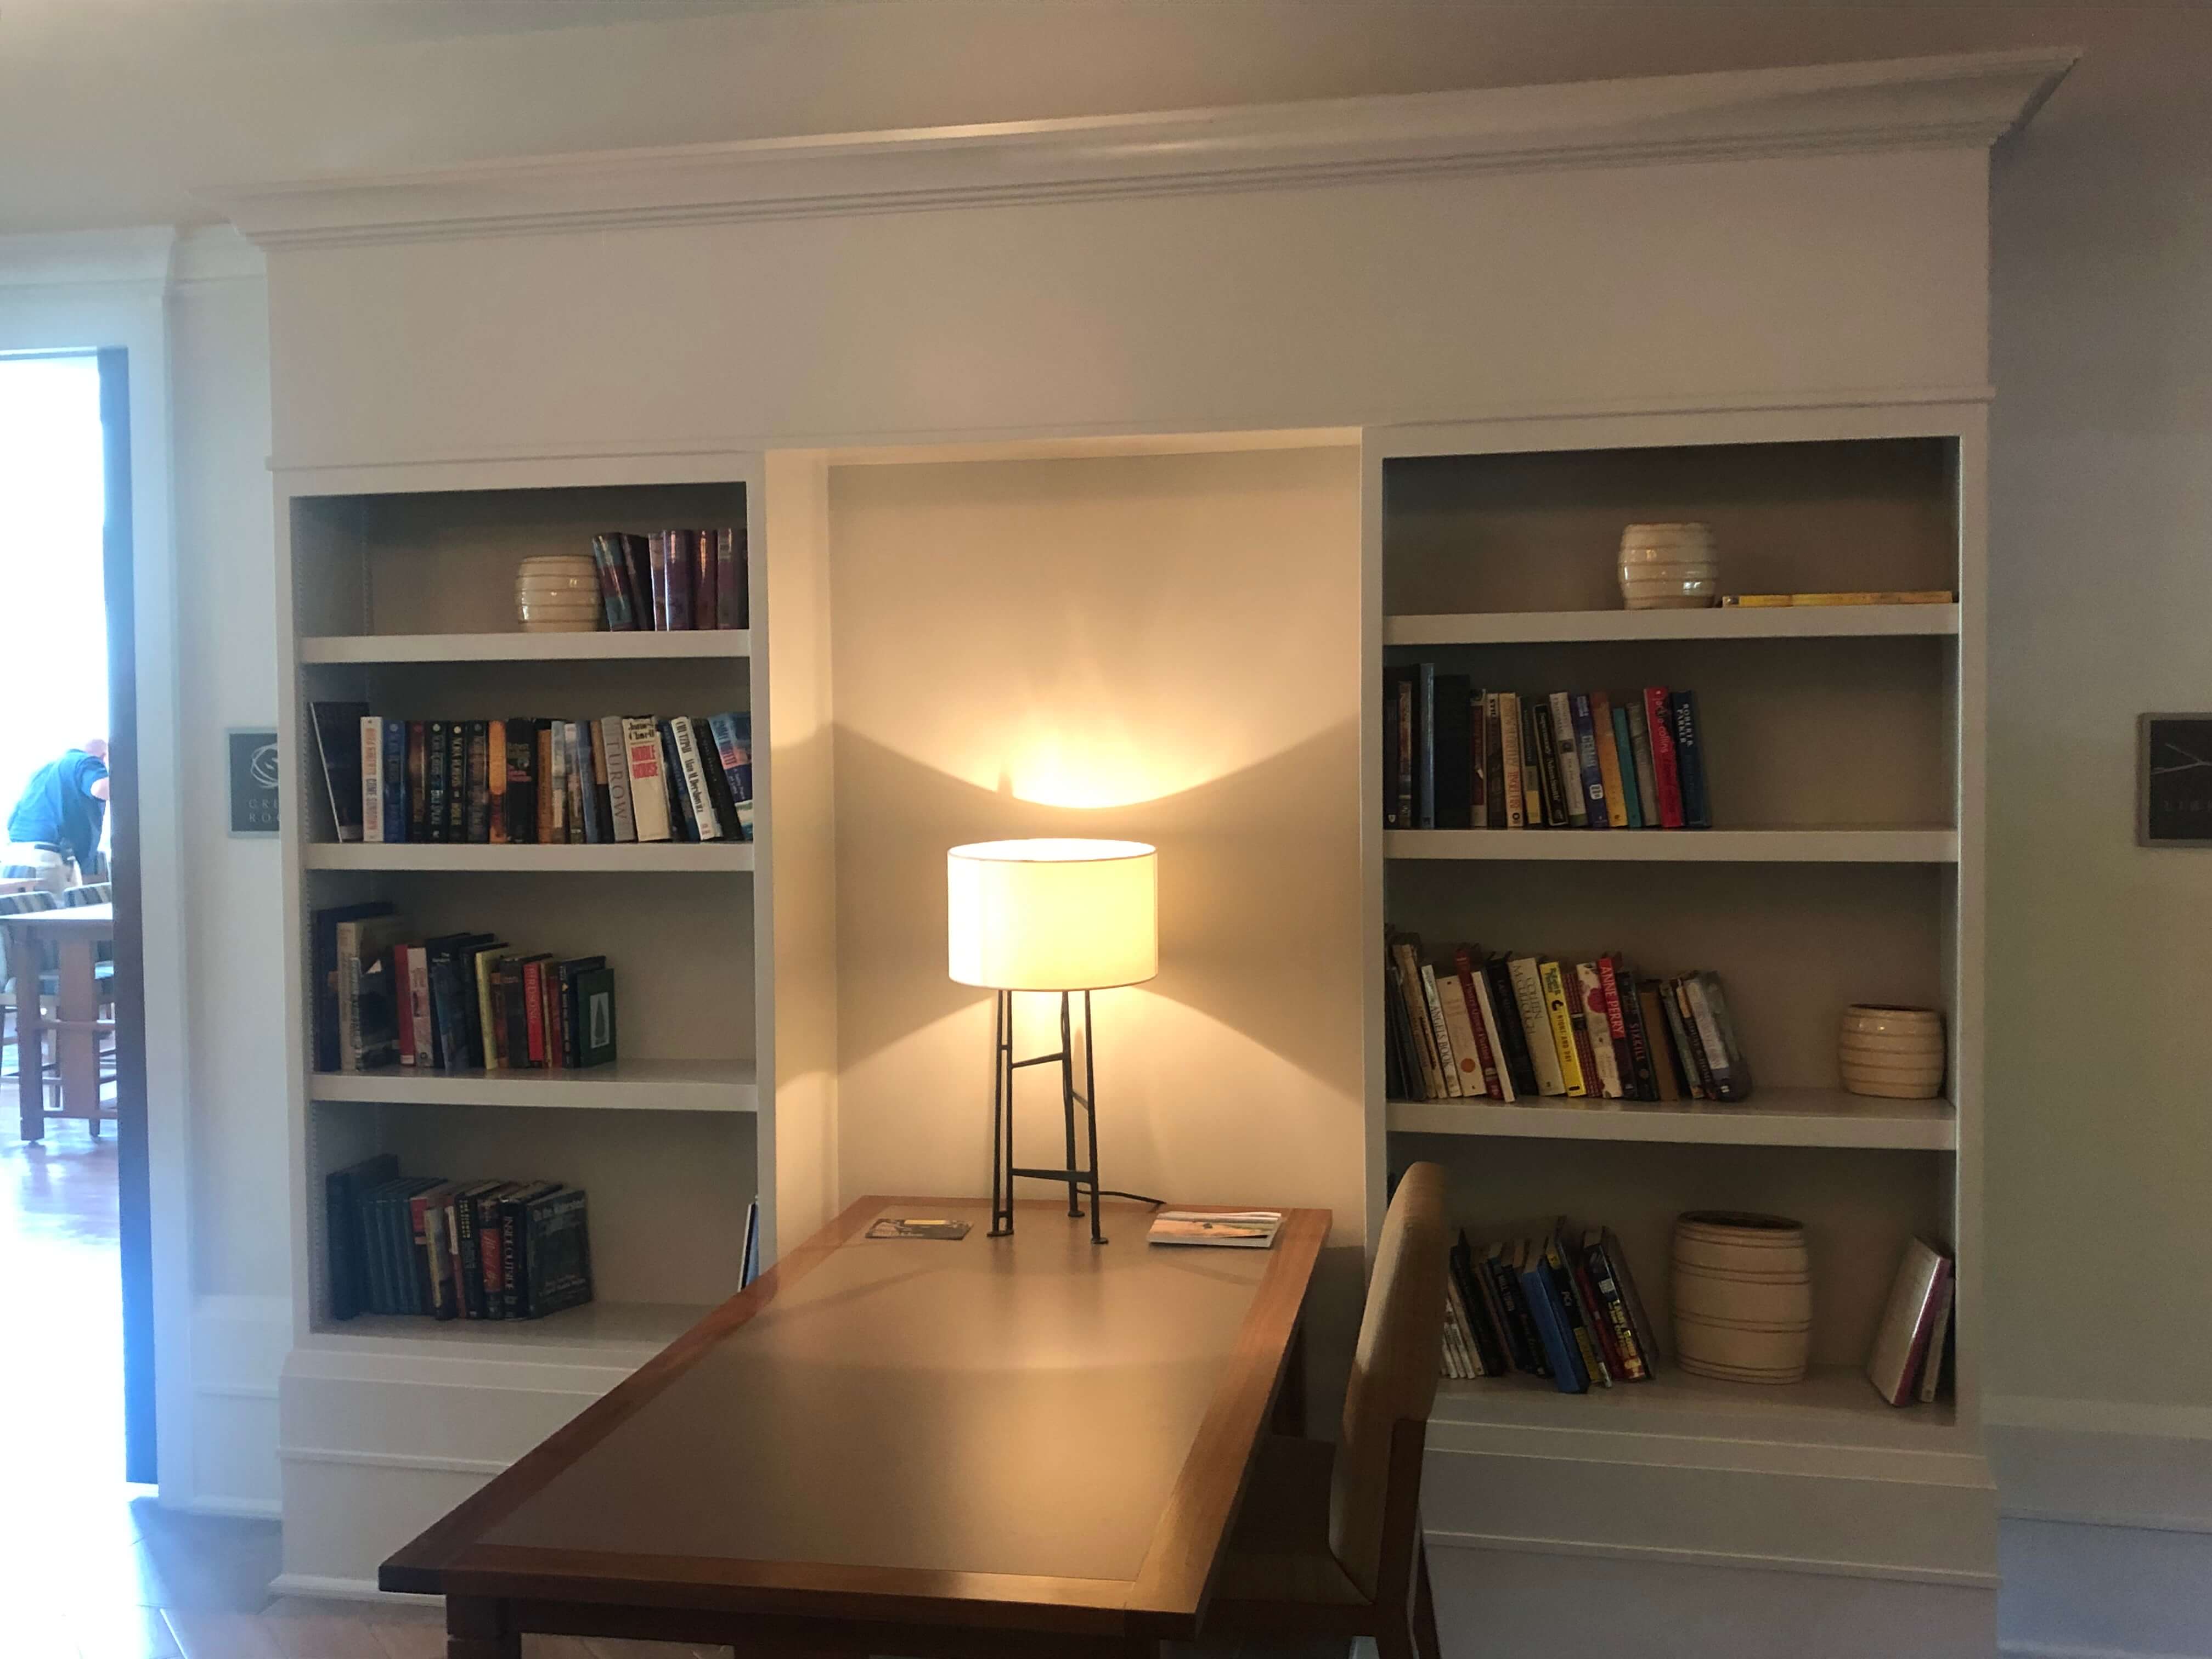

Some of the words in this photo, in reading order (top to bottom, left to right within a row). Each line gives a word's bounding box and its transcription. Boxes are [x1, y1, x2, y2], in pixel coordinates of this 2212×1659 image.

[1657, 725, 1669, 753] collins
[1675, 709, 1686, 743] PARKER
[607, 741, 626, 819] TUROW
[1546, 758, 1556, 778] Adam
[1549, 778, 1560, 800] Smith
[249, 812, 279, 822] RO
[526, 967, 539, 1023] BIRDSONG
[1599, 964, 1617, 997] ANNE
[1525, 976, 1543, 1019] COLLEEN
[1607, 999, 1624, 1034] PERRY
[1438, 1040, 1453, 1068] BOOK
[1560, 1035, 1569, 1048] AND
[1563, 1050, 1572, 1063] DAY
[1629, 1022, 1647, 1063] SIXKILL
